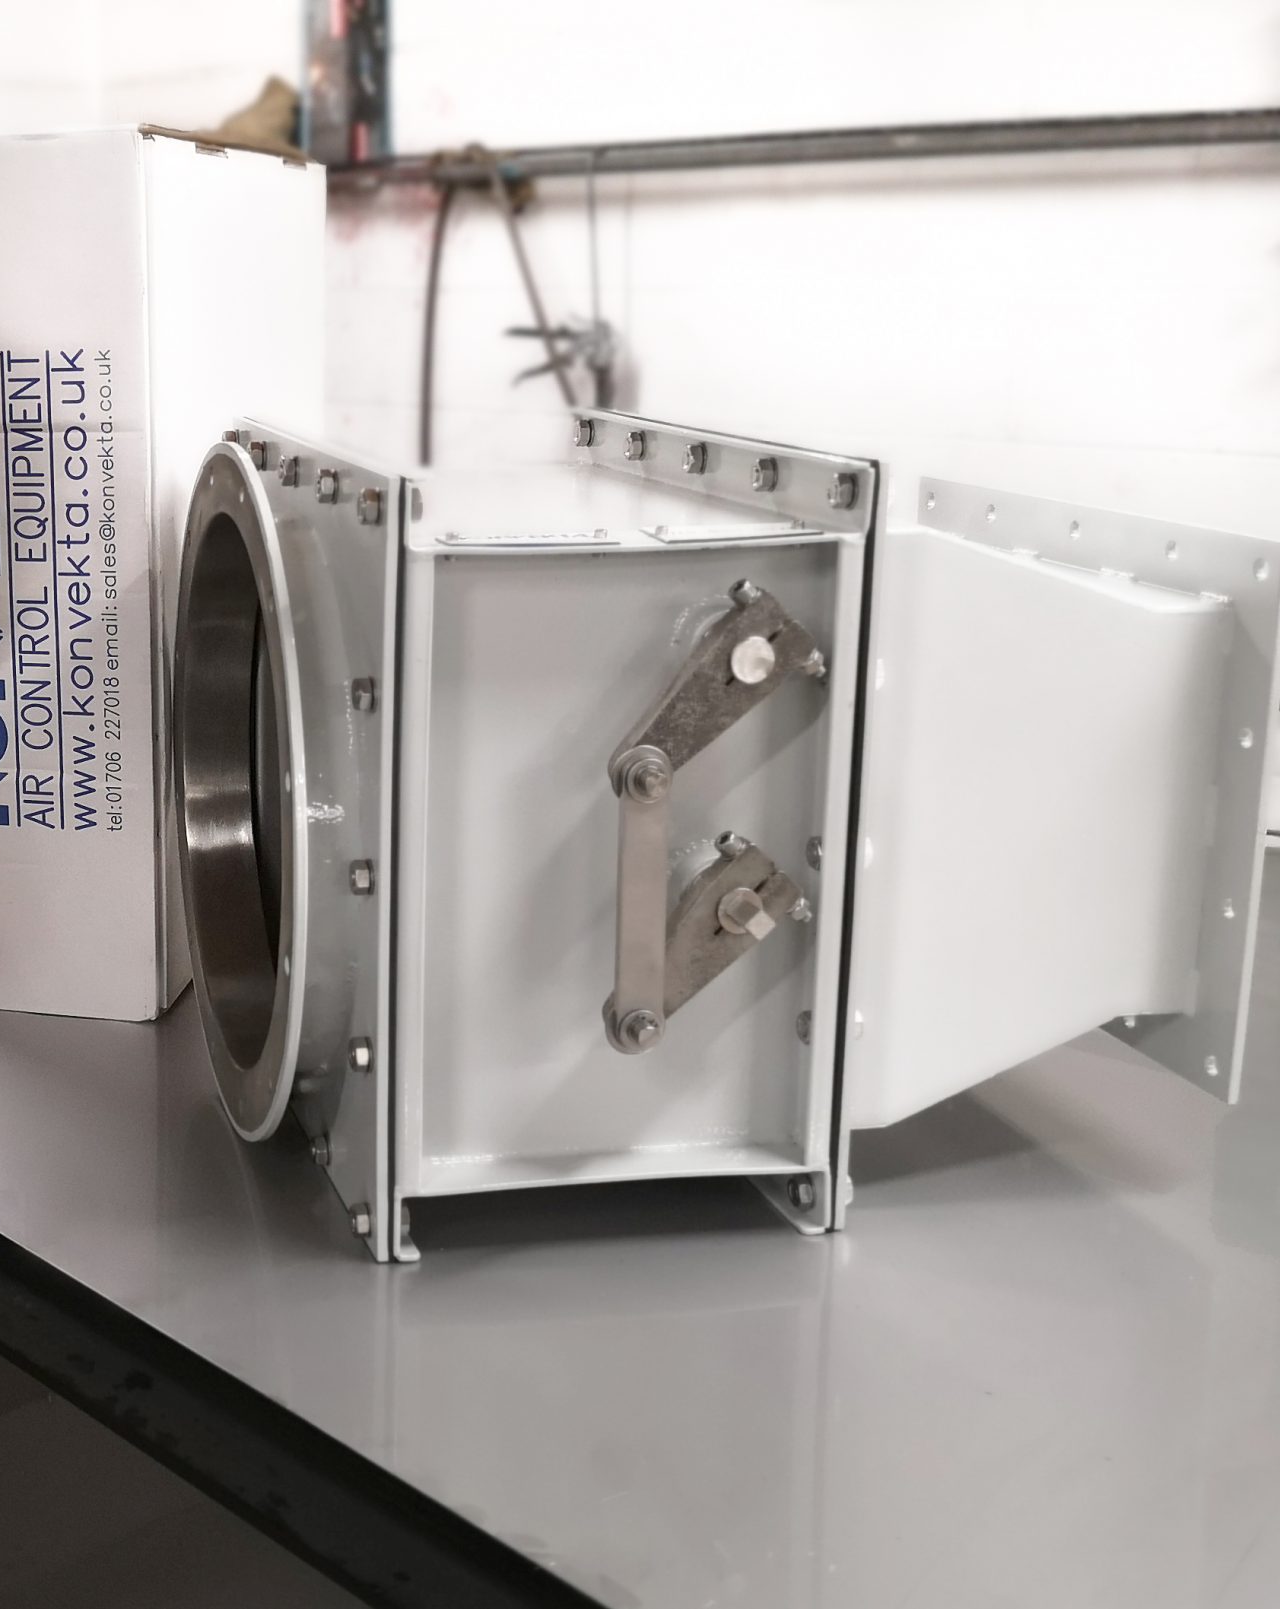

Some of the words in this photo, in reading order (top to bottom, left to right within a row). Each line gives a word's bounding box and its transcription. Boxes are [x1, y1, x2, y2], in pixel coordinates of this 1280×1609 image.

[6, 350, 49, 562] EQUIPMENT
[93, 349, 117, 599] sales@konvekta.co.uk
[16, 586, 53, 750] CONTROL
[51, 348, 97, 830] www.konvekta.co.uk
[101, 605, 118, 670] email:
[103, 676, 121, 740] 227018
[23, 775, 55, 829] AIR
